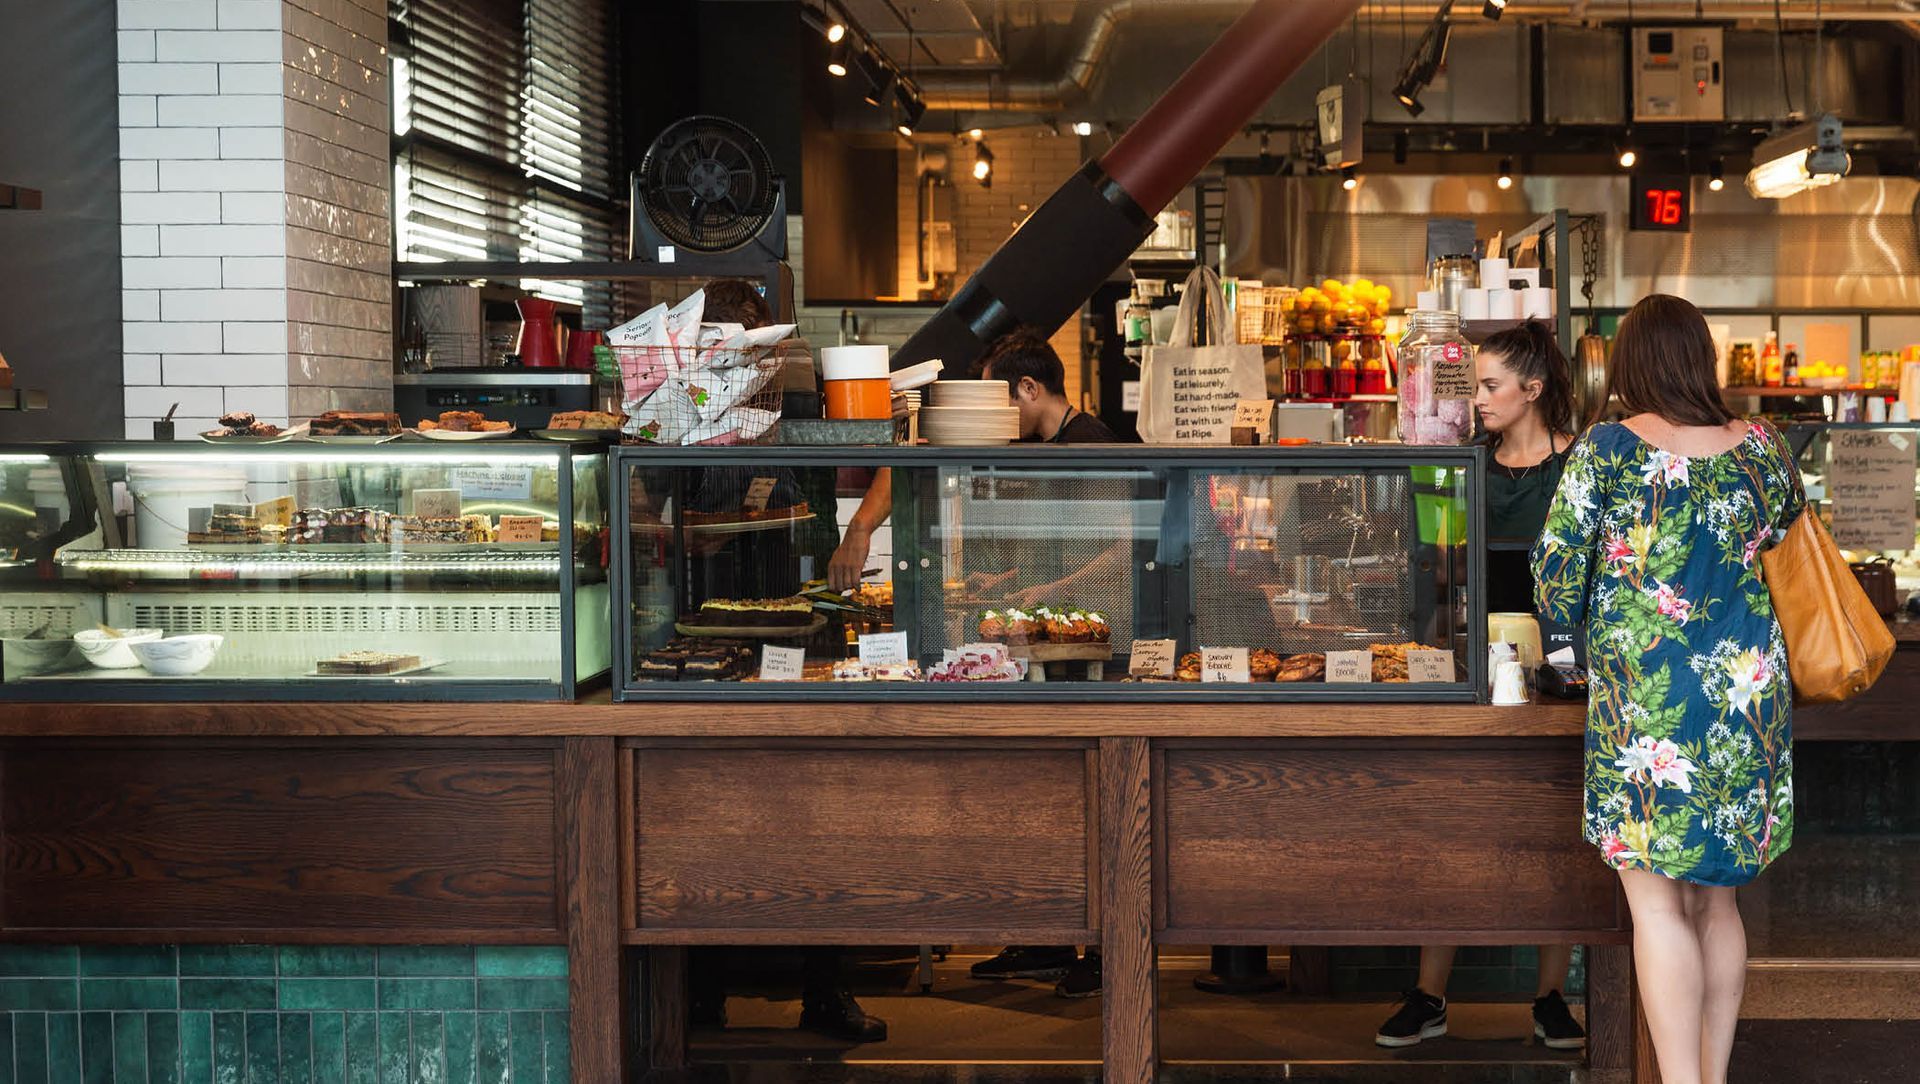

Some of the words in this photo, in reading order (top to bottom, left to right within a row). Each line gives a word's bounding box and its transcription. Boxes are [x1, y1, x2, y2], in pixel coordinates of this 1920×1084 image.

[1646, 189, 1682, 224] 76
[1173, 367, 1187, 376] Eat
[1188, 367, 1196, 376] in
[1198, 366, 1232, 376] season.
[1434, 361, 1463, 371] Raspberry
[1173, 380, 1188, 389] Eat
[1189, 379, 1226, 389] leisurely.
[1174, 393, 1188, 402] Eat
[1189, 391, 1242, 401] hand-made.
[1174, 405, 1189, 414] Eat
[1190, 404, 1209, 413] with
[1211, 403, 1237, 412] friend
[1175, 417, 1189, 426] Eat
[1191, 416, 1210, 426] with
[1212, 418, 1224, 426] us.
[1176, 430, 1190, 439] Eat
[1192, 429, 1214, 439] Ripe.
[1550, 633, 1573, 642] FEC
[1217, 672, 1227, 681] $6
